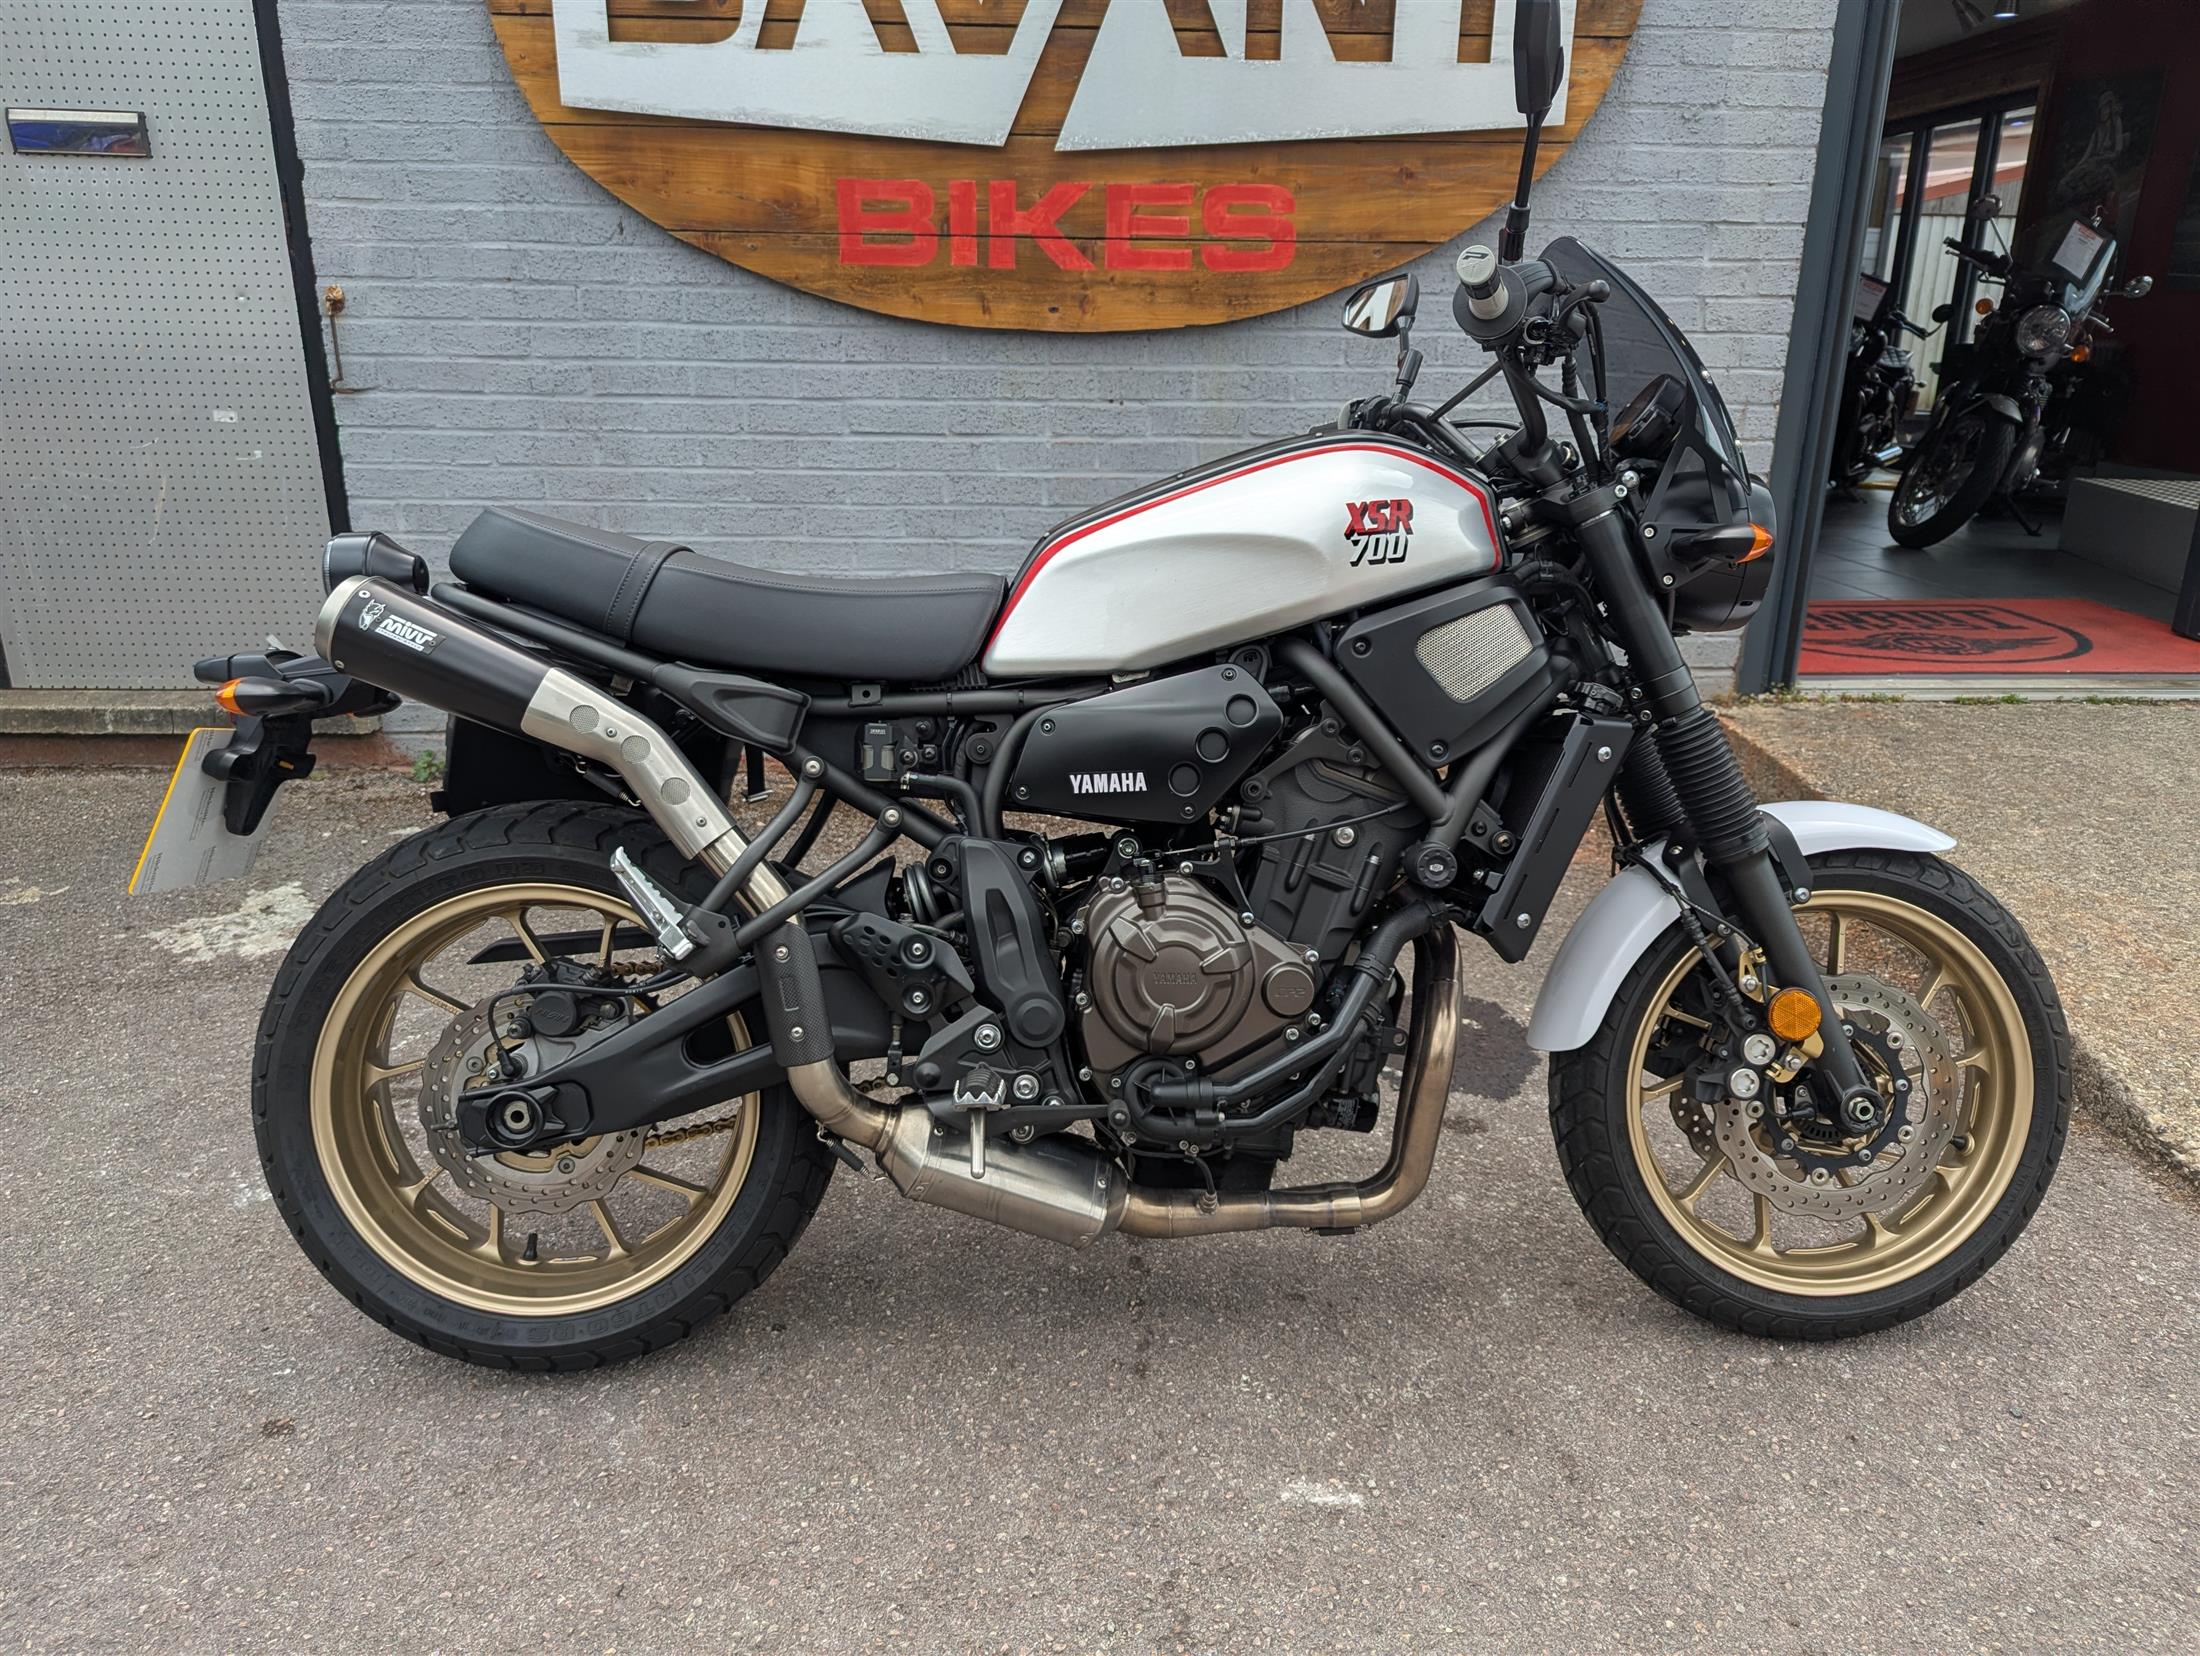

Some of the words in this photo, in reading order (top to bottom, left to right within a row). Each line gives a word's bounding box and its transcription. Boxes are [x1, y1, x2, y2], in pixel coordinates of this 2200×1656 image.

[837, 179, 1297, 272] BIKES
[1344, 499, 1413, 540] XSR
[1350, 534, 1408, 567] 700
[1069, 772, 1147, 794] YAMAHA
[1153, 972, 1198, 985] YAMAHA
